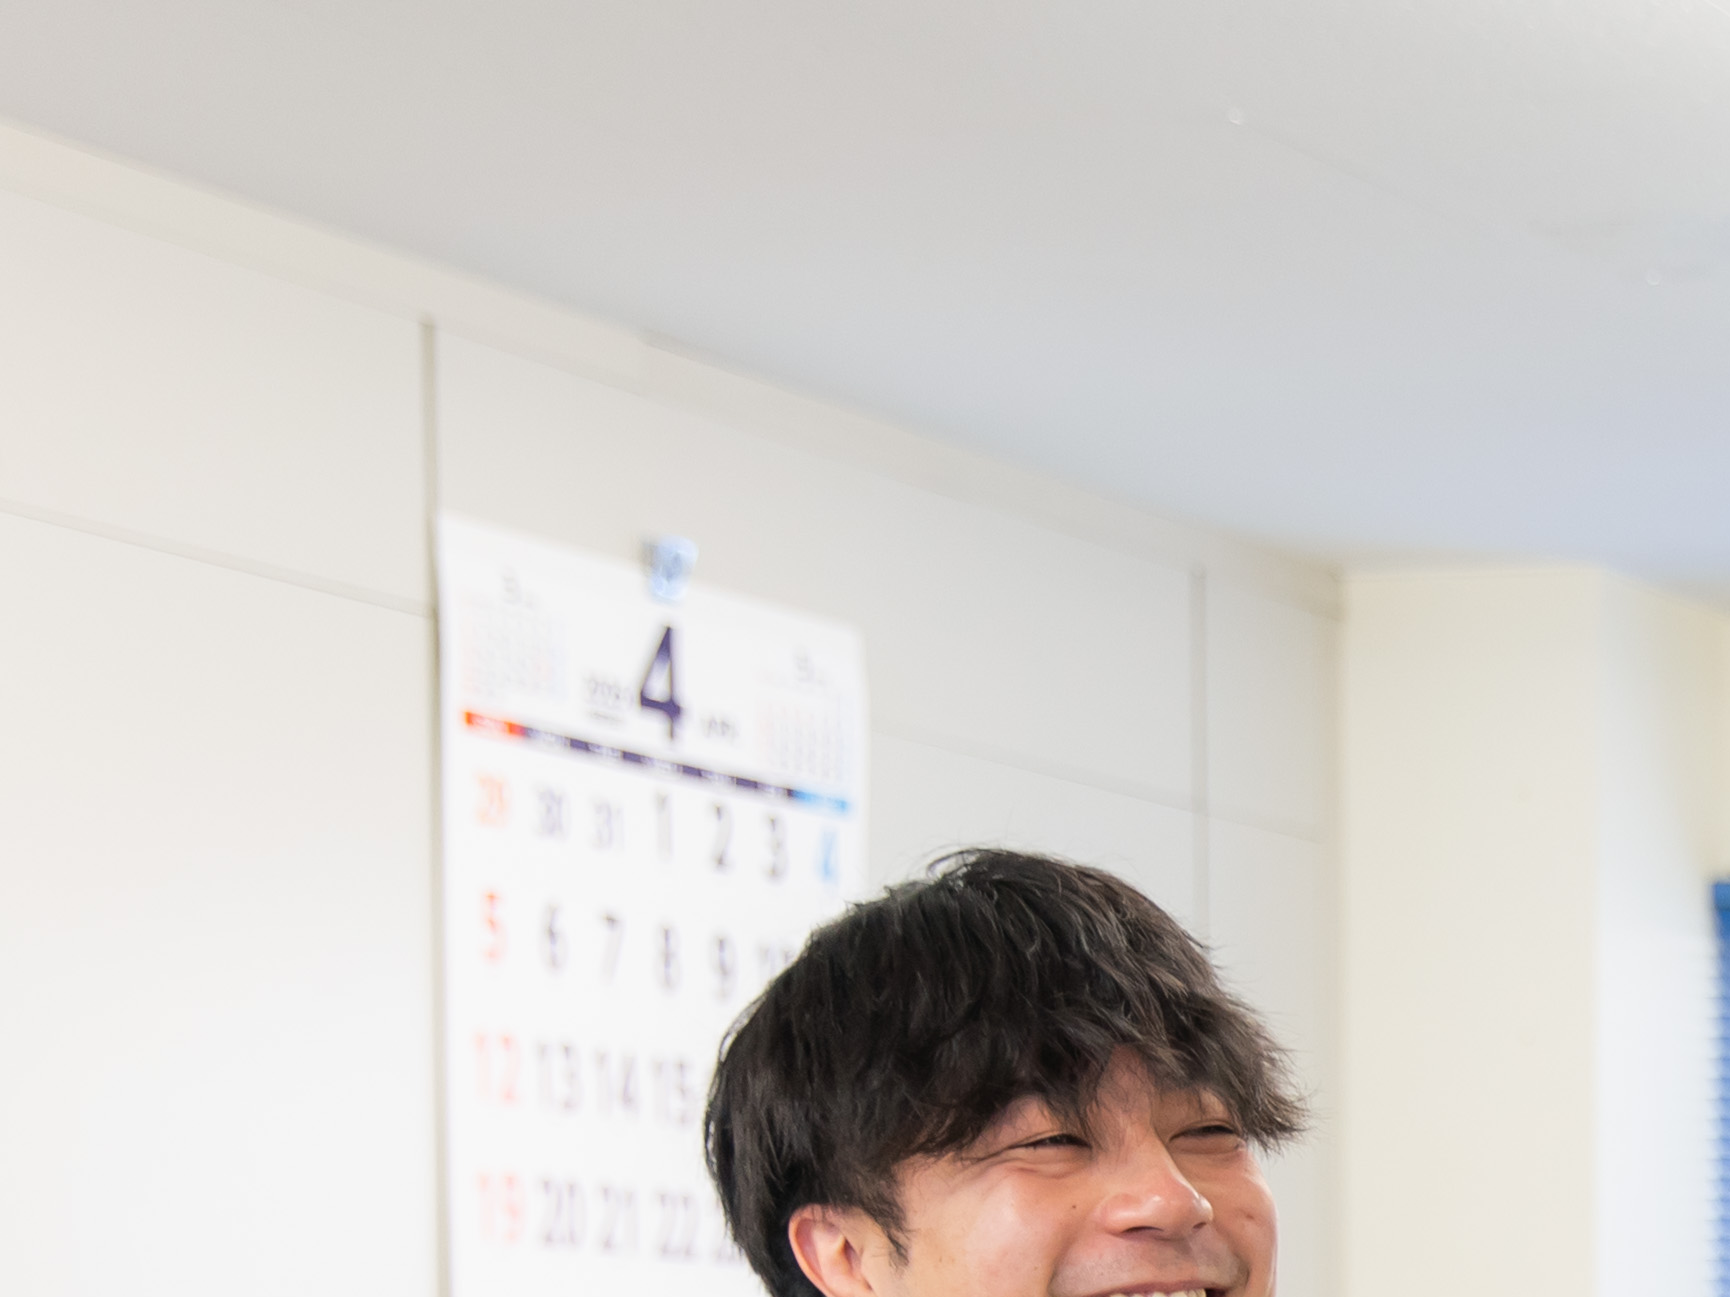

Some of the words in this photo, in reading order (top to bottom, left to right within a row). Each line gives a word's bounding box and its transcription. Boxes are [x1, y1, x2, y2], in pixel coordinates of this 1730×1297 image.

[640, 625, 681, 742] 4
[654, 790, 675, 860] 1
[711, 802, 734, 873] 2
[765, 812, 789, 883] 3
[481, 888, 508, 964] 5
[539, 902, 568, 974] 6
[600, 911, 625, 985] 7
[656, 922, 682, 992] 8
[713, 934, 738, 1003] 9
[472, 1032, 521, 1107] 12
[536, 1040, 584, 1114] 13
[595, 1048, 641, 1118] 14
[651, 1057, 699, 1129] 15
[475, 1171, 527, 1244] 19
[539, 1177, 587, 1250] 20
[598, 1184, 641, 1255] 21
[655, 1191, 700, 1261] 22
